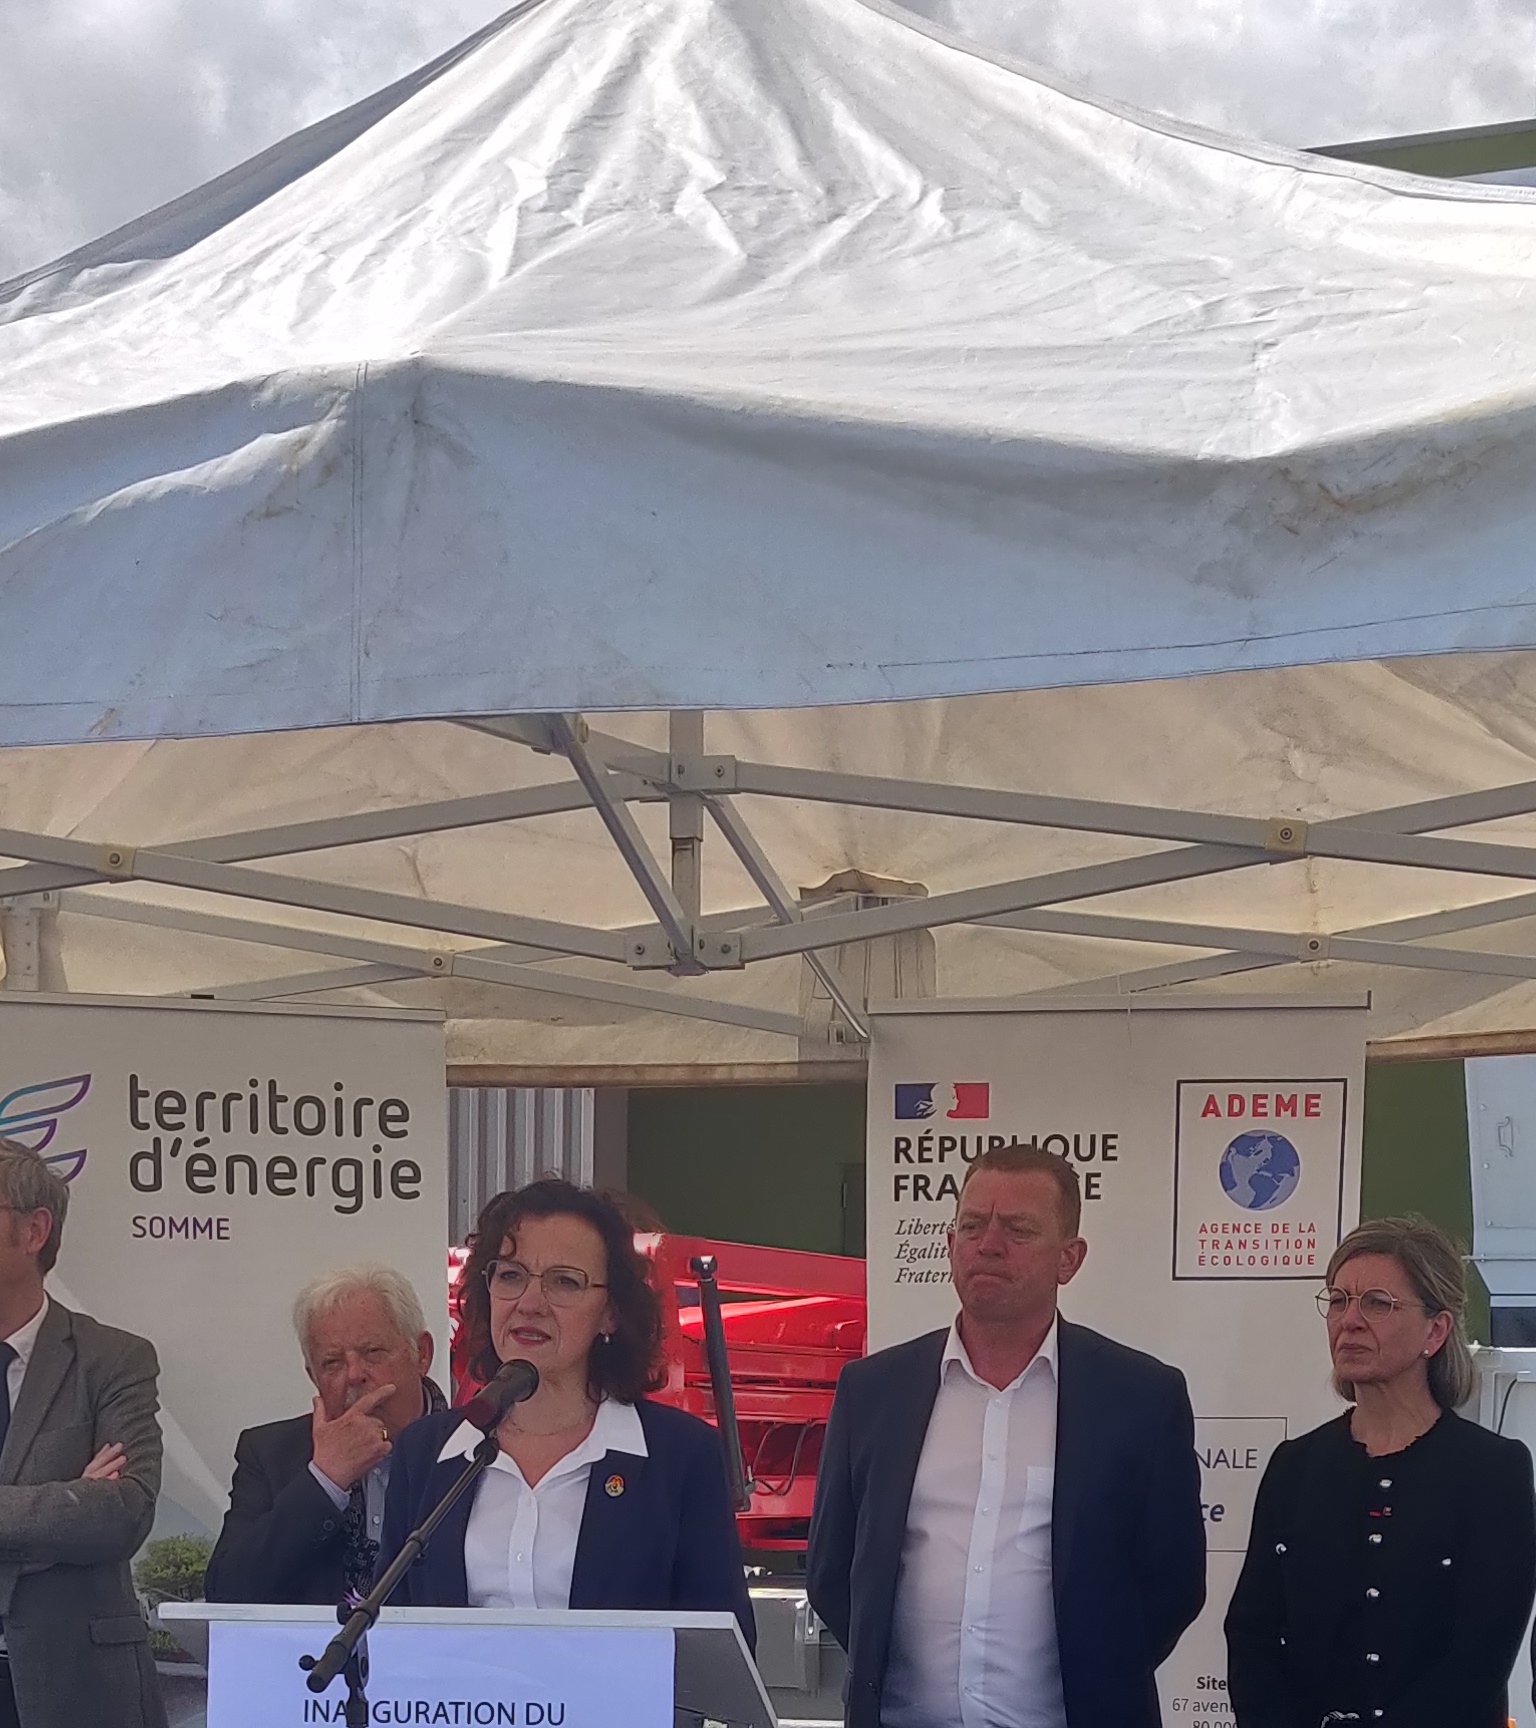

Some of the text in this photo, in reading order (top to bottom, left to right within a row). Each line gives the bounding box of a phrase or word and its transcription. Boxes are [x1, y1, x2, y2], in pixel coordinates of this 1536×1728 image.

[129, 1073, 410, 1139] territoire
[1200, 1093, 1322, 1118] ADEME
[129, 1136, 422, 1214] d'énergie
[132, 1216, 231, 1241] SOMME
[1199, 1222, 1316, 1235] AGENCE DE LA
[1198, 1238, 1316, 1250] TRANSITION
[1198, 1251, 1316, 1266] ÉCOLOGIQUE
[894, 1268, 955, 1285] Frater
[1196, 1448, 1258, 1469] NALE
[1196, 1676, 1227, 1691] Site
[303, 1699, 565, 1727] INAGURATION DU
[1172, 1698, 1235, 1713] 67 aven
